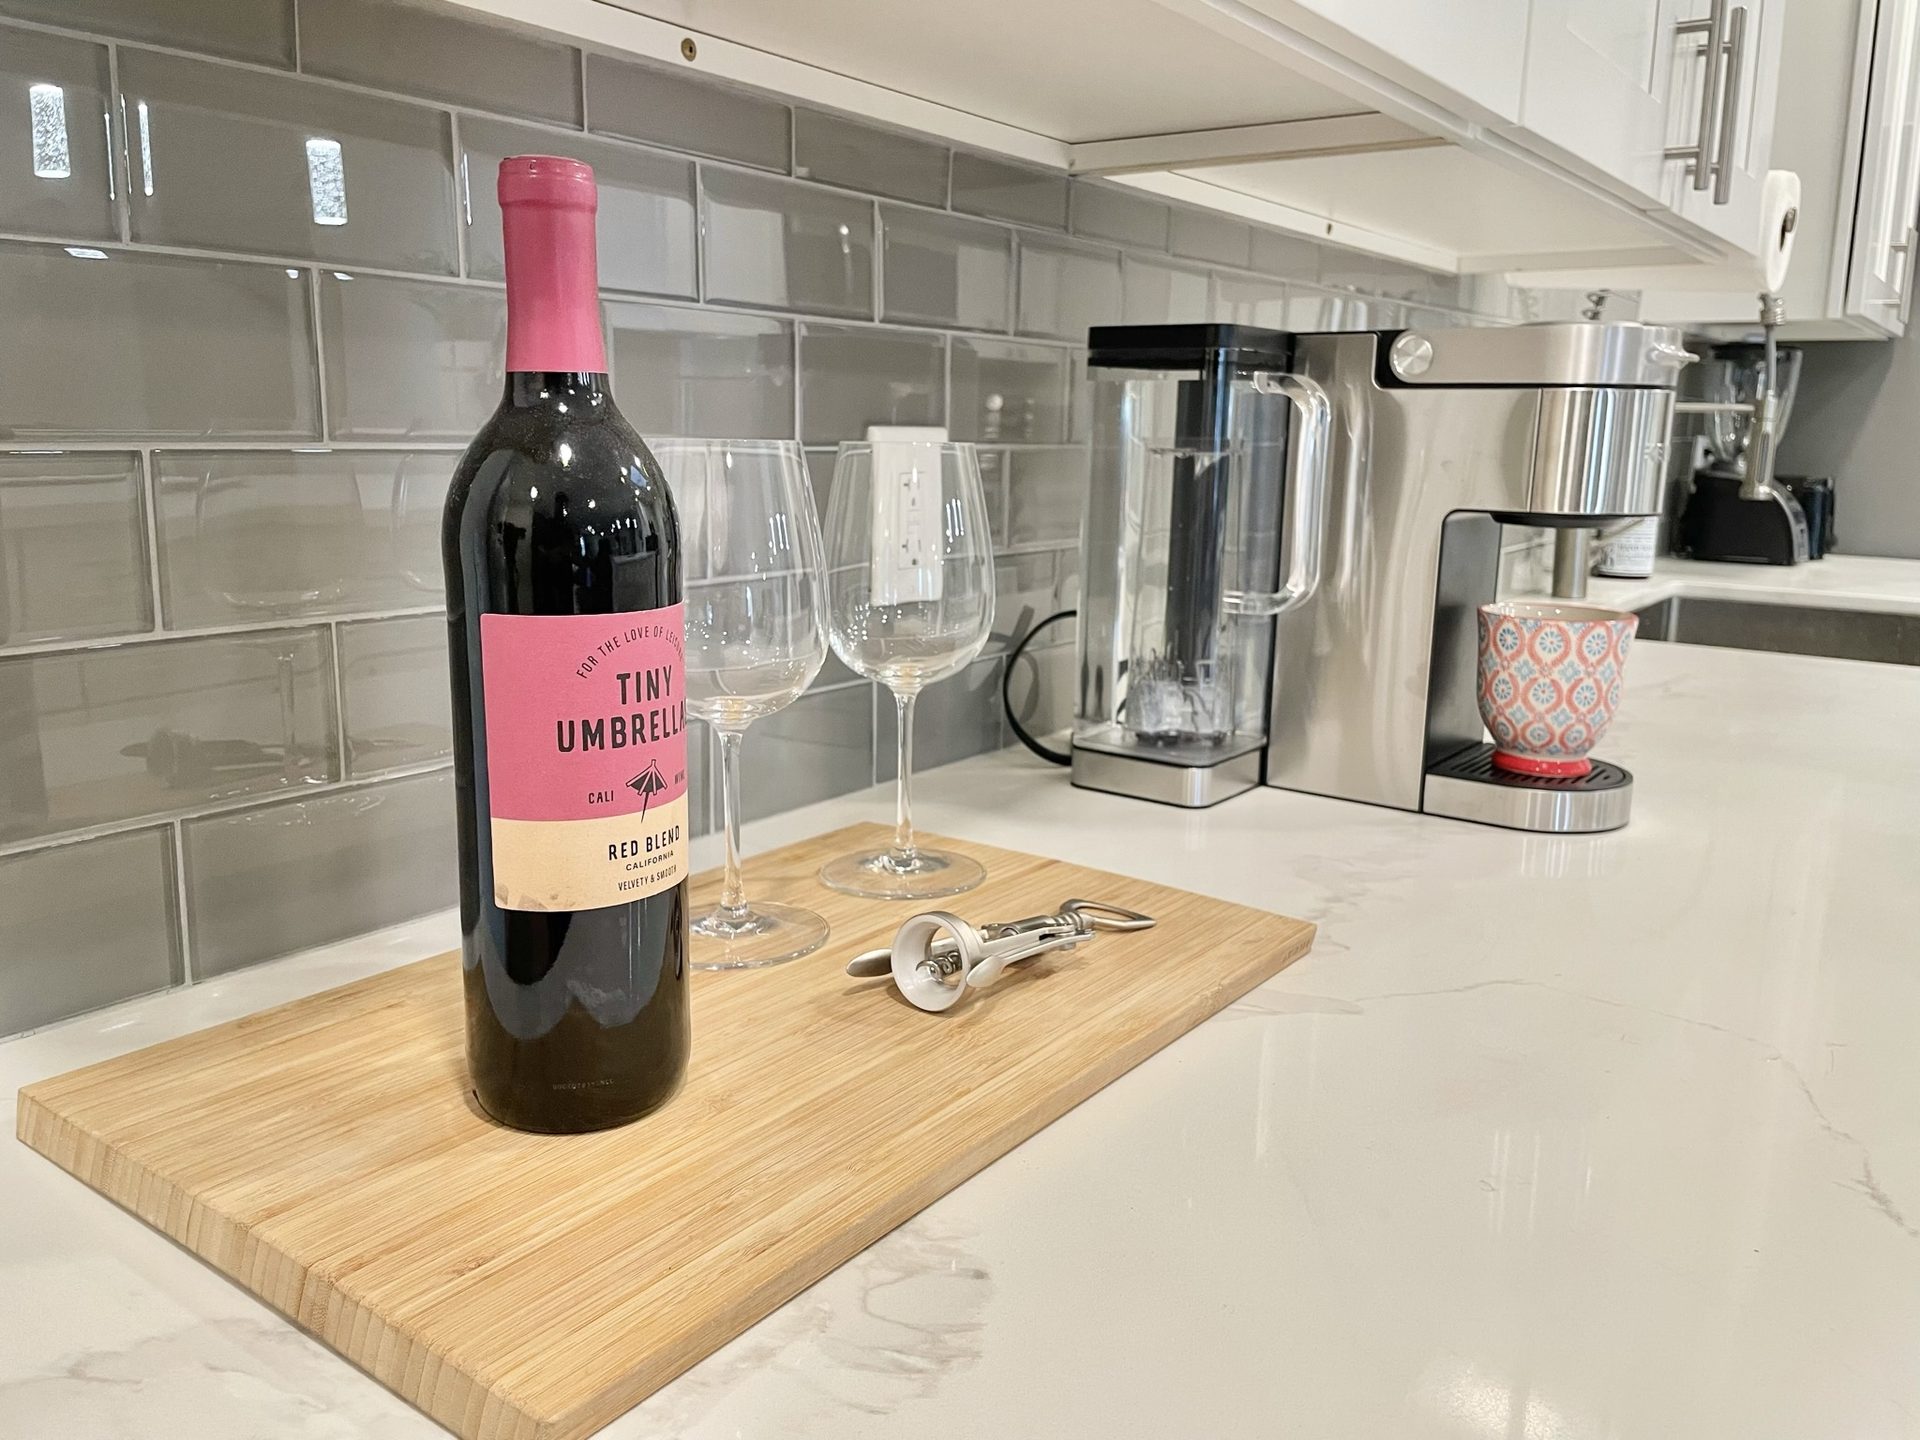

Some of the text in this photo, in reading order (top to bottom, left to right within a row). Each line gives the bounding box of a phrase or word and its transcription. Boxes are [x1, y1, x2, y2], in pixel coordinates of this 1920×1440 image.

[576, 655, 599, 679] FOR
[597, 636, 621, 656] THE
[624, 625, 649, 643] LOVE
[653, 625, 663, 638] OF
[616, 664, 672, 705] TINY
[588, 790, 614, 804] CALI
[608, 825, 680, 861] RED BLEND
[625, 850, 674, 871] CALIFORNIA
[618, 864, 677, 891] VELVETY & SMOOTH
